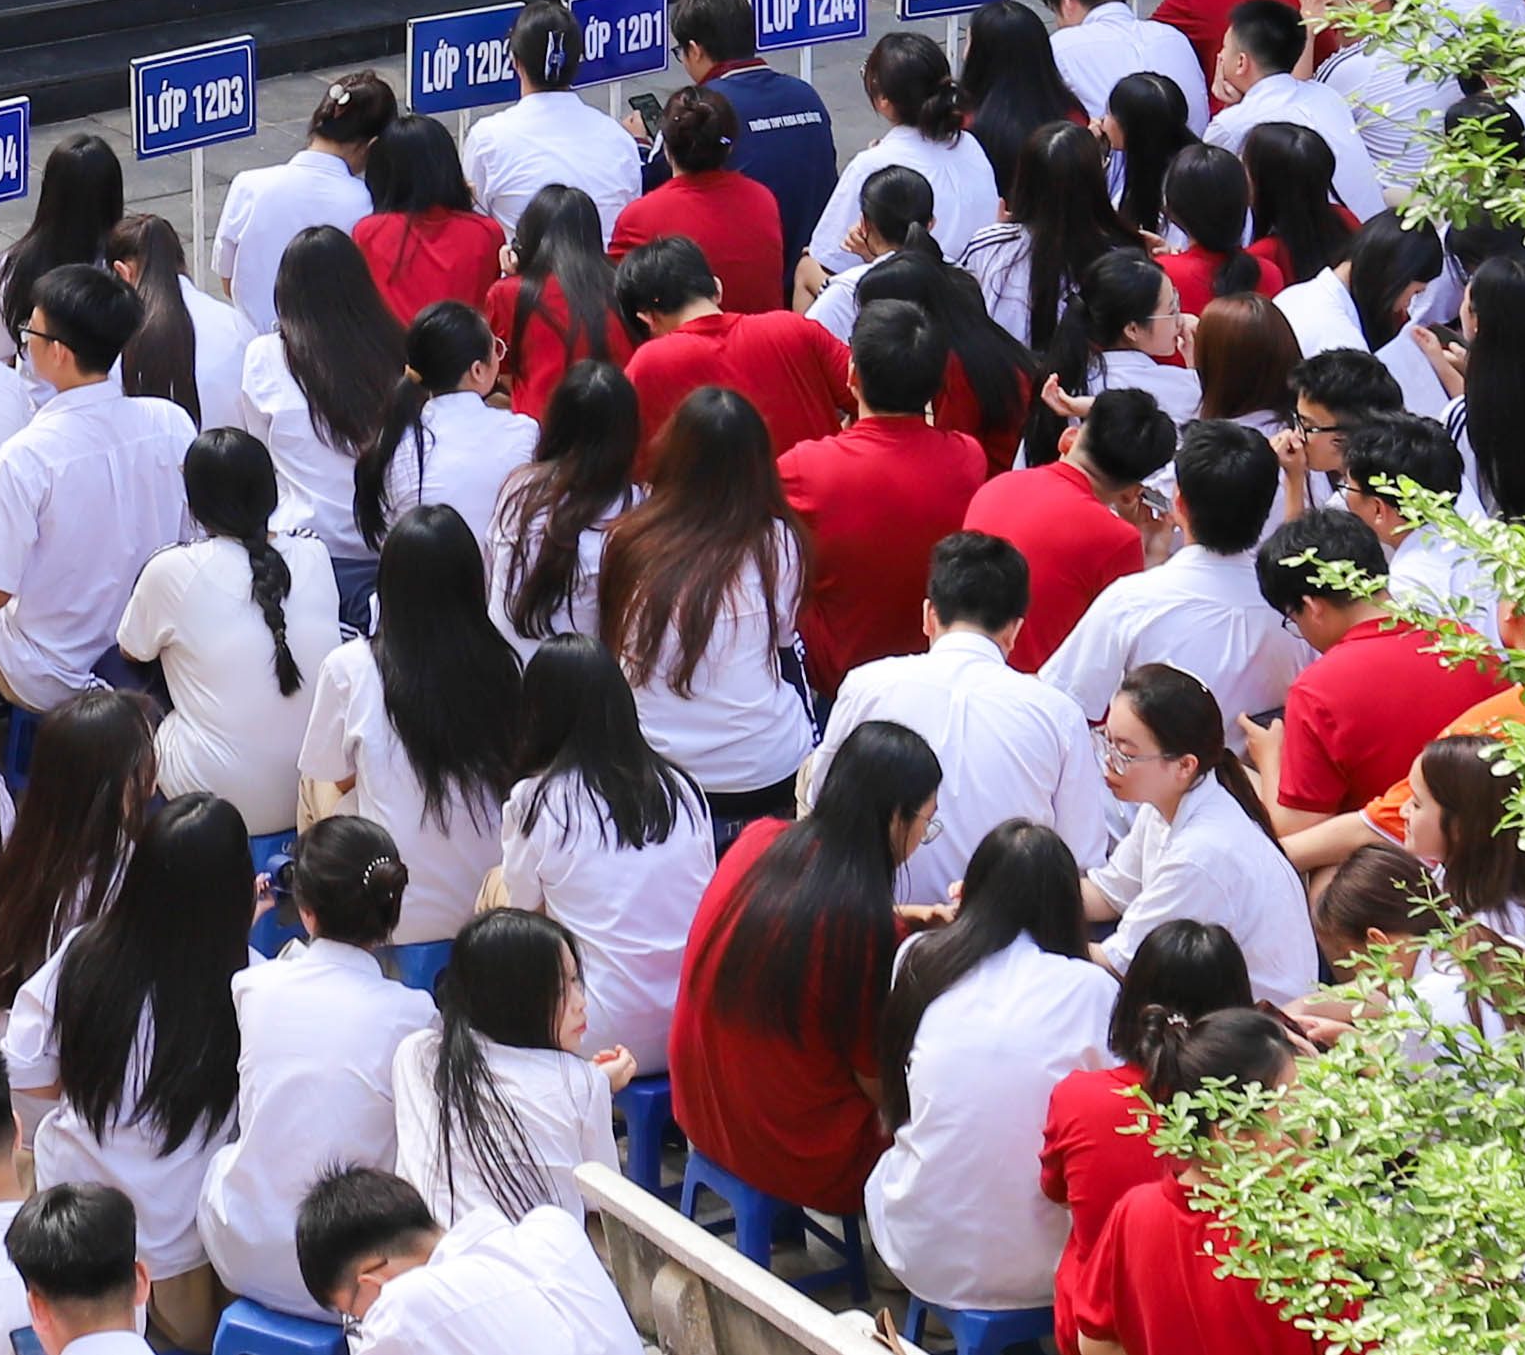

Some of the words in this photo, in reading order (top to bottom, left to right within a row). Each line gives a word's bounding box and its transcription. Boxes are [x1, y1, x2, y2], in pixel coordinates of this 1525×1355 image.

[421, 33, 460, 94] LỚP
[579, 15, 611, 62] ỚP
[615, 8, 663, 54] 12D1
[146, 78, 187, 134] LỚP
[192, 75, 245, 125] 12D3
